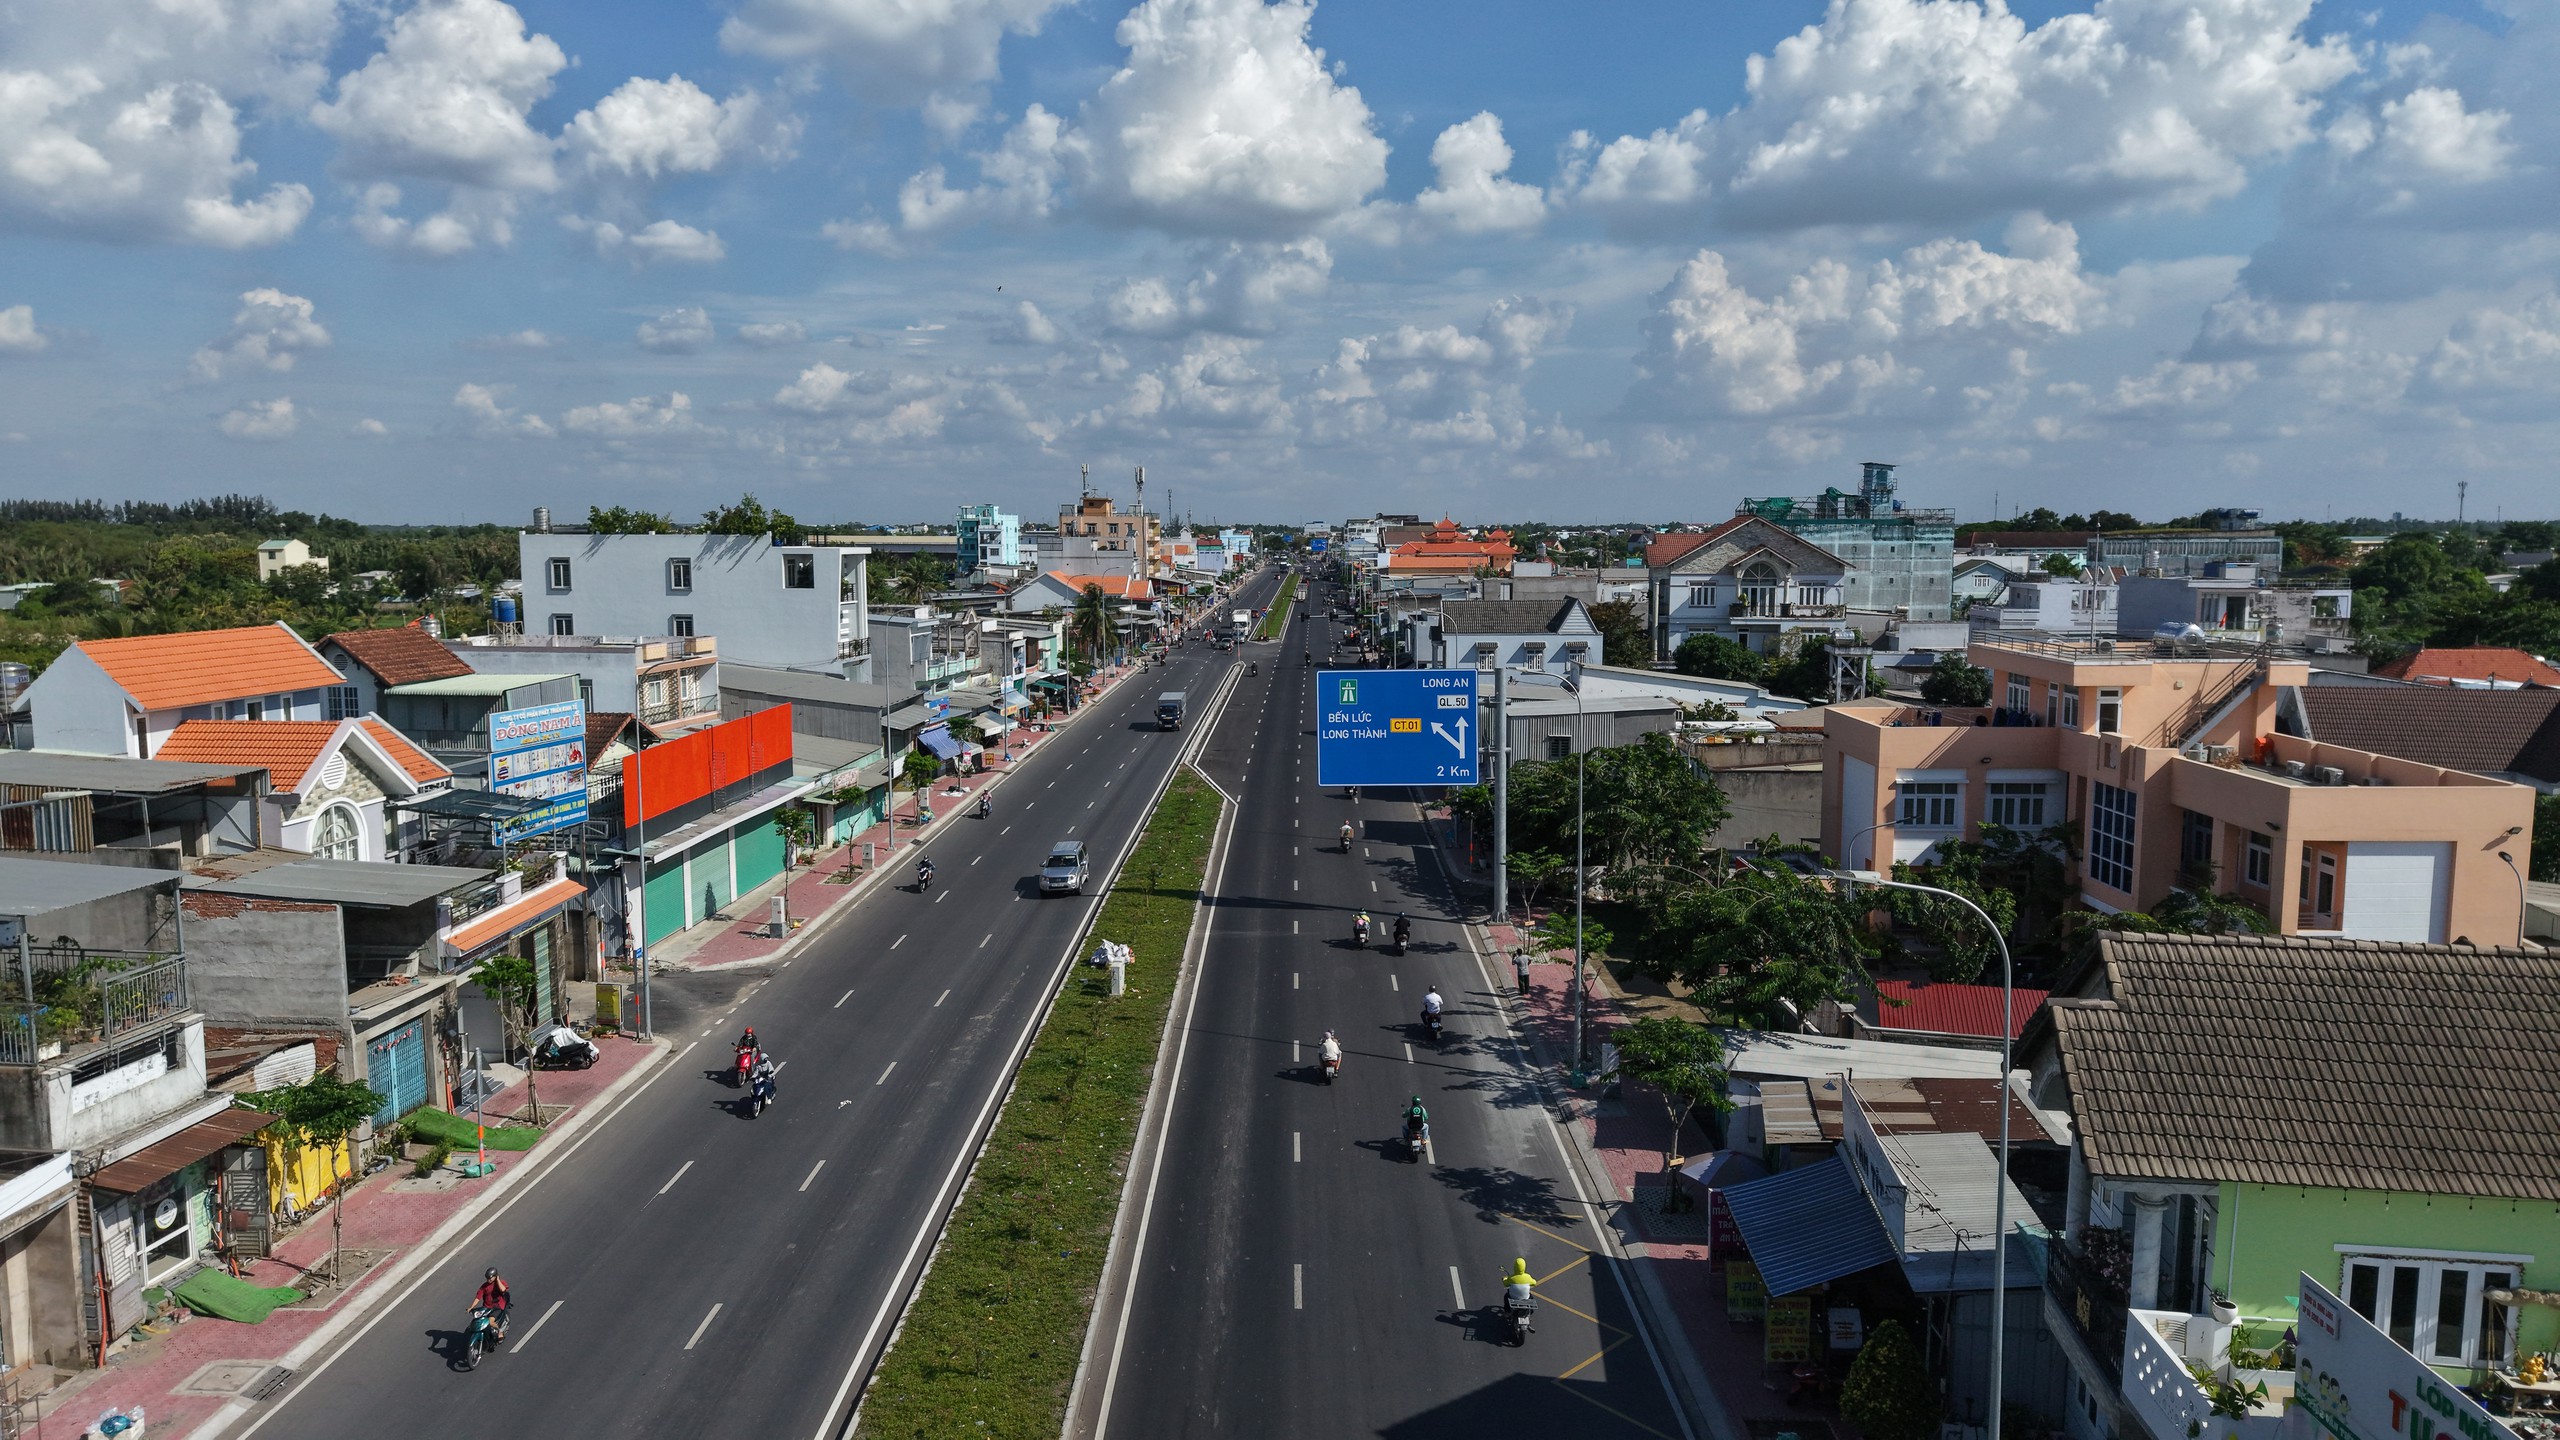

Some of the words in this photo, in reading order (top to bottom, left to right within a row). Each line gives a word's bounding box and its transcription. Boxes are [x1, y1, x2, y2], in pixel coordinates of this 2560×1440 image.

[1422, 678, 1450, 688] LONG
[1453, 678, 1469, 688] AN
[1439, 697, 1467, 707] QL.50
[1328, 710, 1349, 723] BẾN
[1352, 710, 1372, 723] LỨC
[497, 722, 538, 740] ĐÔNG
[540, 716, 570, 733] NAM
[1394, 721, 1418, 730] CT.01
[1322, 730, 1349, 739] LONG
[1353, 727, 1387, 739] THÀNH
[1437, 766, 1444, 777] 2
[1450, 766, 1470, 777] Km
[1734, 1282, 1757, 1291] PIZZA
[2416, 1376, 2455, 1418] LỚP
